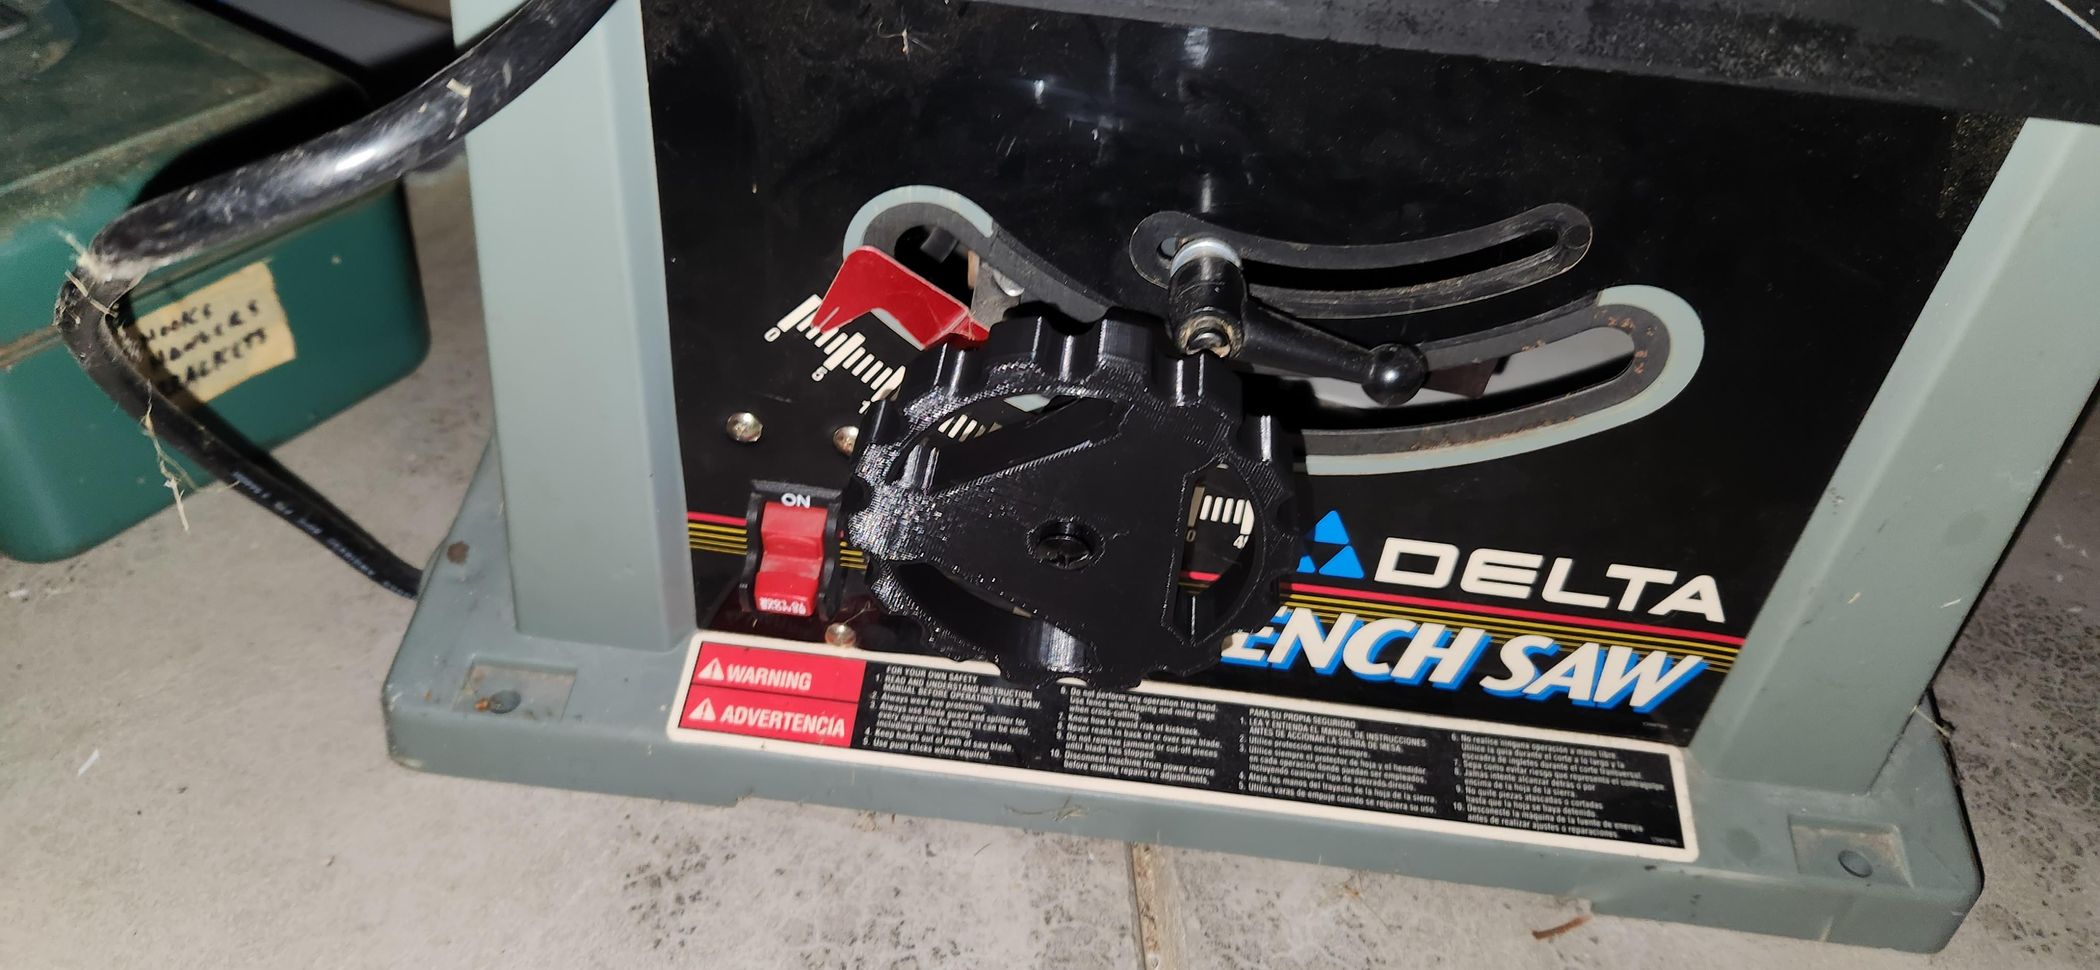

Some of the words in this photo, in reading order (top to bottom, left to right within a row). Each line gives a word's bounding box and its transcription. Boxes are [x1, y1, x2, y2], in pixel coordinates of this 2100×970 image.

[780, 492, 811, 508] ON
[1374, 536, 1726, 623] DELTA
[1221, 606, 1490, 690] ENCH
[1479, 635, 1708, 713] SAW
[727, 664, 812, 691] WARNING
[720, 704, 845, 738] ADVERTENCIA
